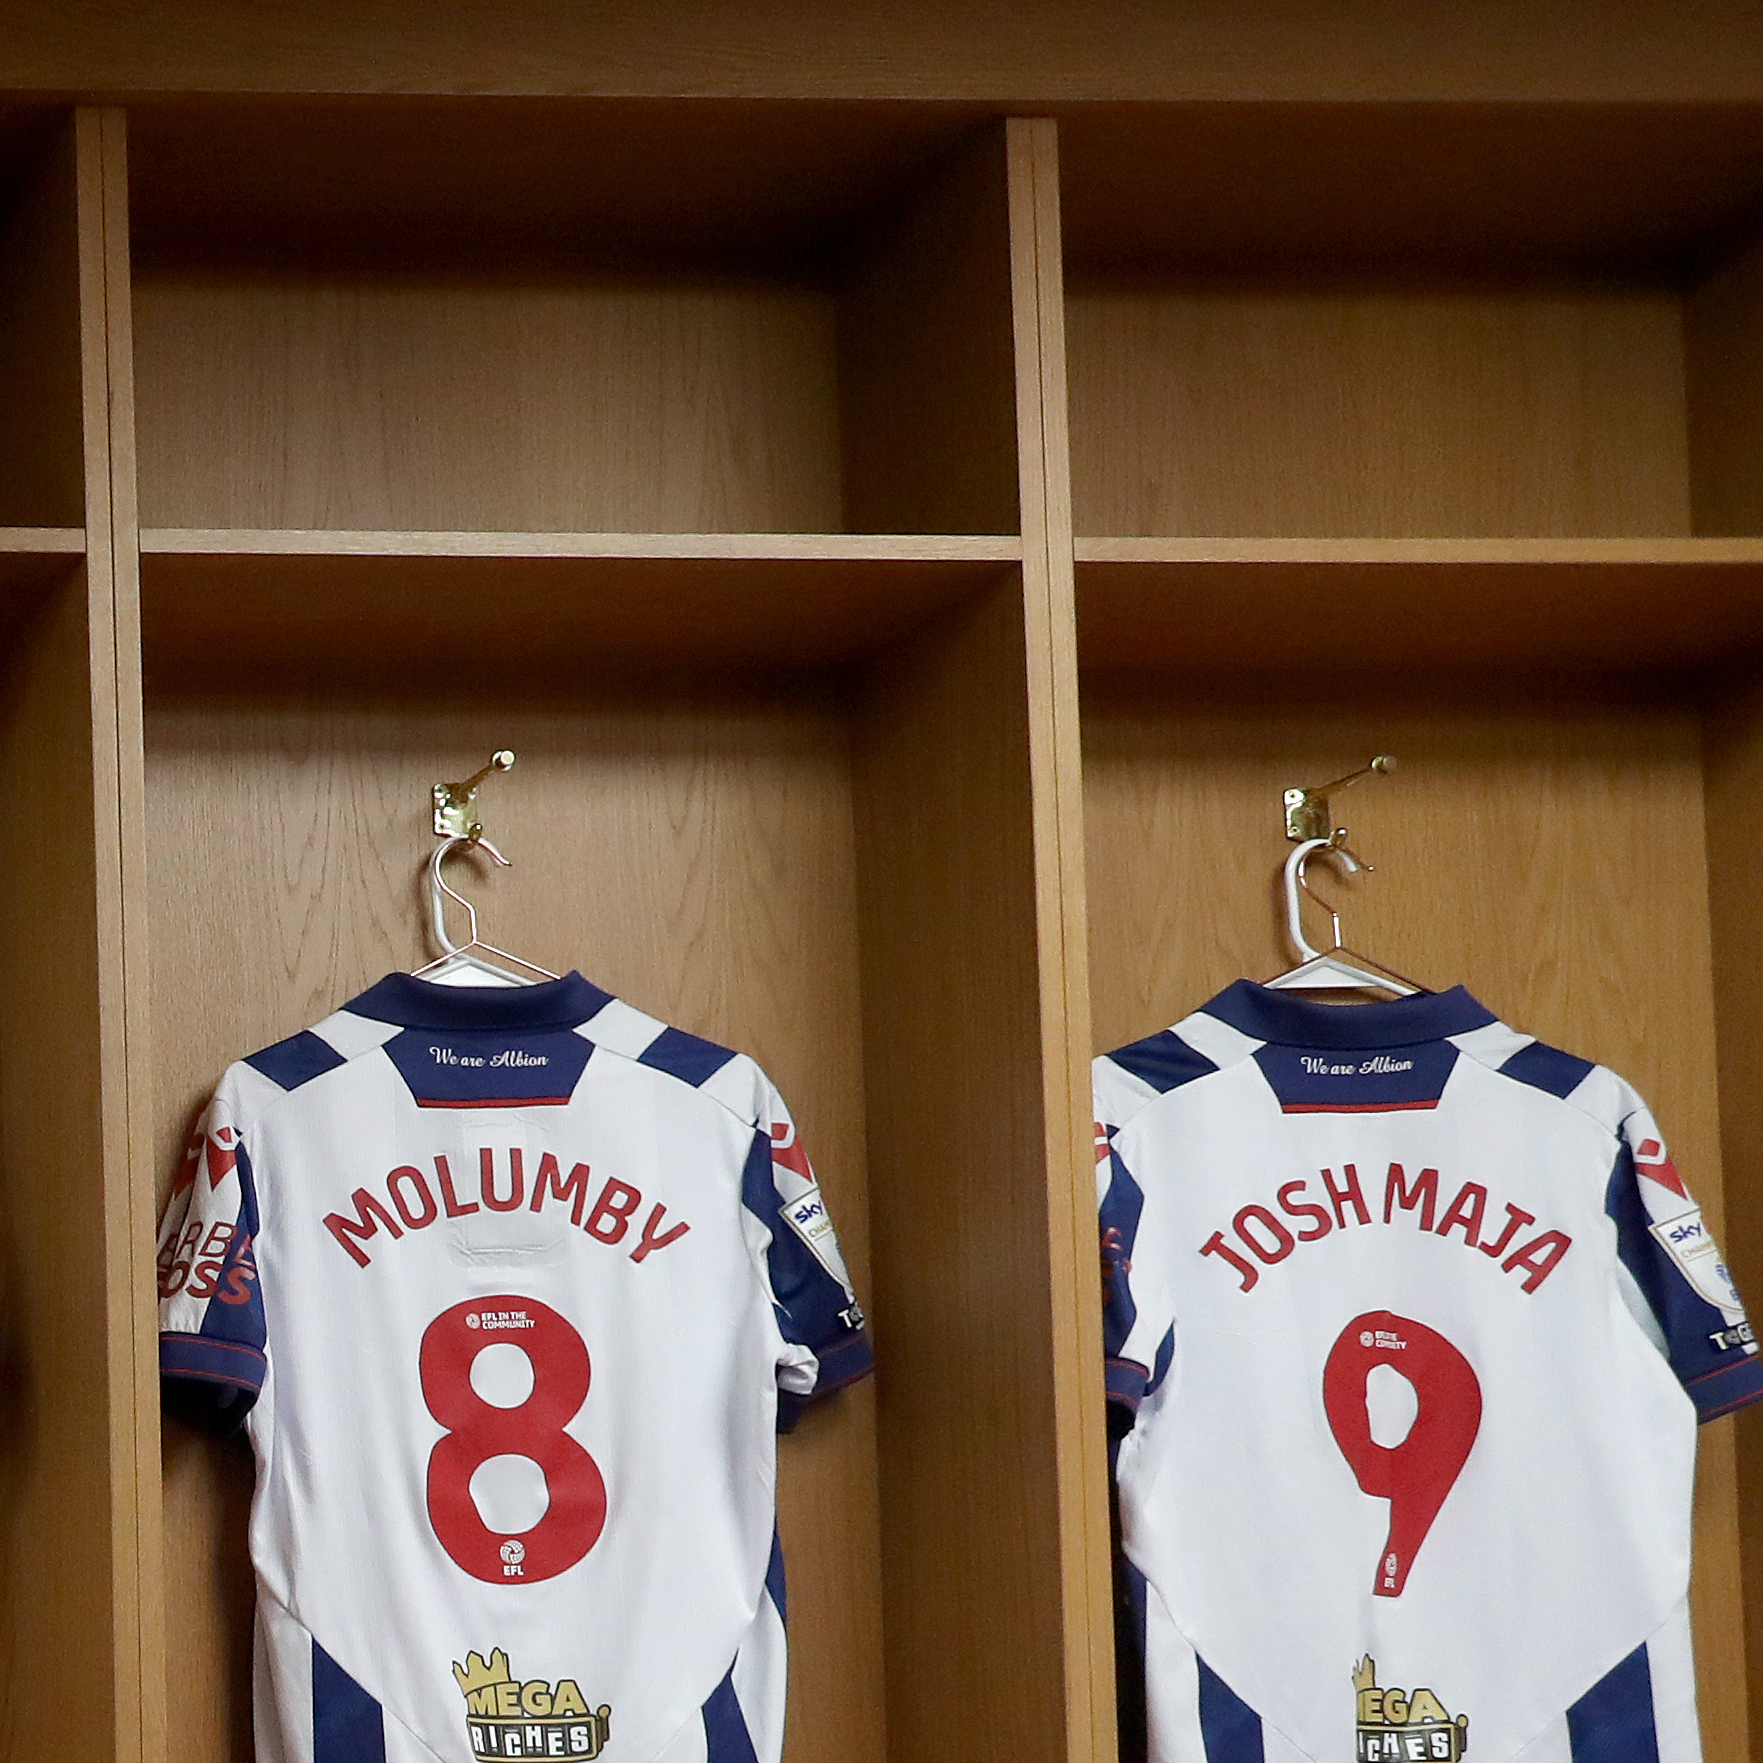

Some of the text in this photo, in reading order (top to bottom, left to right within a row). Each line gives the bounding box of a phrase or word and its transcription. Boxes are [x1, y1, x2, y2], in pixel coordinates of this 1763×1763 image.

[429, 1046, 550, 1068] We are Albion
[1300, 1056, 1414, 1076] We are Albion
[322, 1147, 692, 1269] MOLUMBY
[794, 1201, 823, 1224] sky
[1198, 1163, 1373, 1294] JOSH
[1383, 1162, 1573, 1295] MAJA
[1669, 1222, 1702, 1243] sky
[419, 1295, 607, 1585] 8
[1323, 1310, 1482, 1597] 9
[503, 1565, 525, 1576] EFL
[468, 1679, 591, 1717] MEGA
[1358, 1687, 1451, 1725] EGA
[470, 1724, 590, 1757] RICHES
[1358, 1731, 1449, 1762] ICHES
